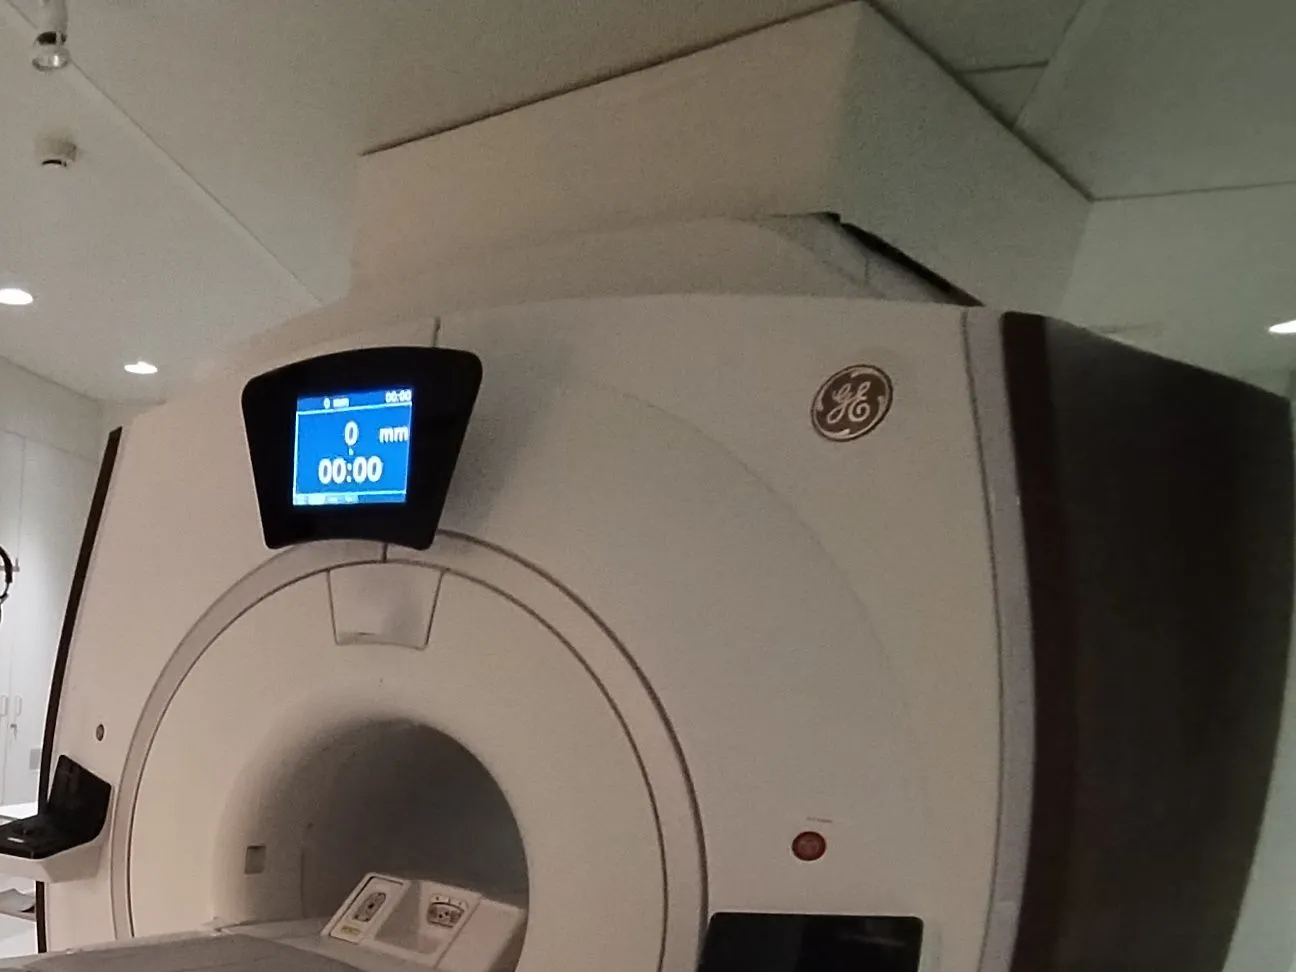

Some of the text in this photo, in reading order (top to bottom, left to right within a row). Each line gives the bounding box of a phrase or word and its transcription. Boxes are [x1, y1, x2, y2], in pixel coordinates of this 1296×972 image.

[345, 421, 408, 446] 0 mm
[318, 456, 383, 484] 00:00
